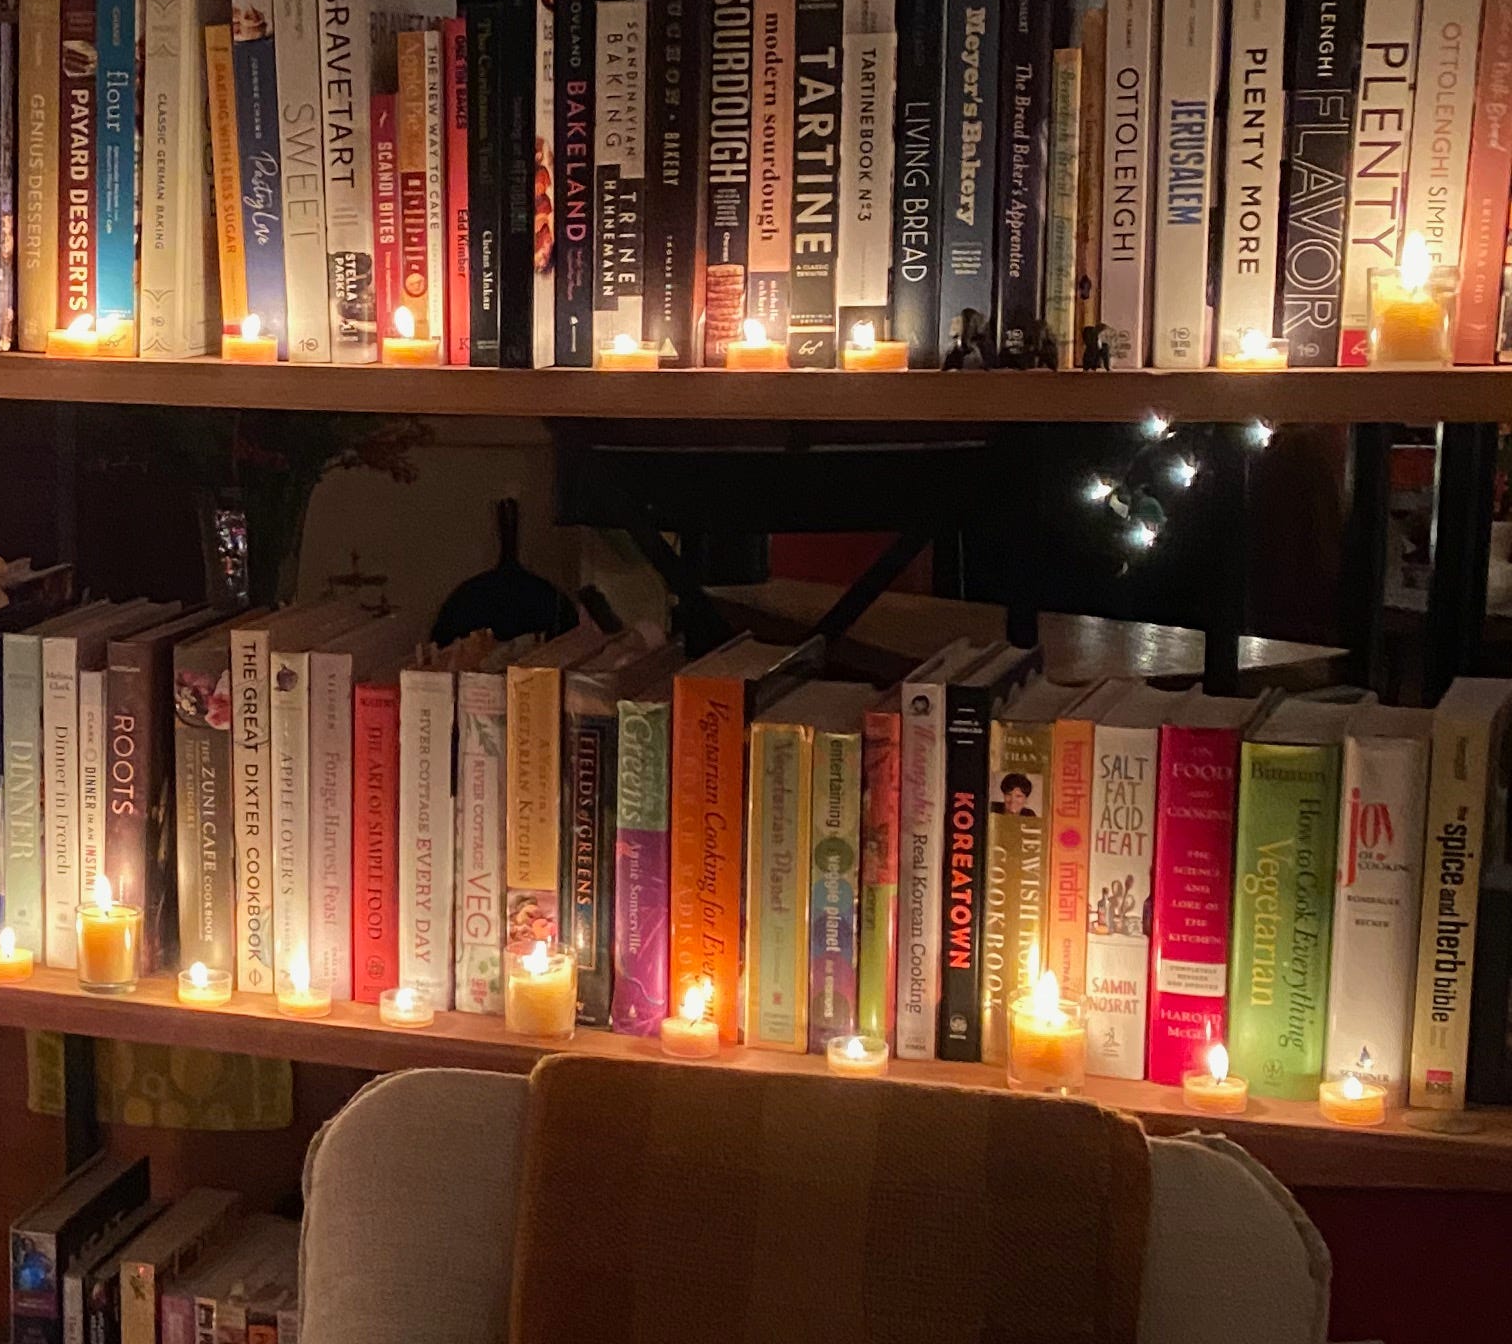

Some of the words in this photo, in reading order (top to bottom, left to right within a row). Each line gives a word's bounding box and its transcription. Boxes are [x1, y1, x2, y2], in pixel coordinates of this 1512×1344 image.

[428, 46, 438, 78] THE
[625, 22, 640, 157] SCANDINAVIAN
[762, 12, 781, 106] modern
[859, 48, 876, 126] TARTINE
[960, 6, 985, 118] Meyer's
[1014, 63, 1032, 90] The
[105, 70, 127, 132] flour
[156, 94, 167, 145] CLASSIC
[215, 63, 229, 120] BAKING
[428, 83, 439, 119] NEW
[456, 89, 467, 129] BAKES
[605, 34, 623, 147] BAKING
[1010, 96, 1031, 139] Bread
[1240, 47, 1268, 172] PLENTY
[1429, 22, 1462, 179] OTTOLENGHI
[28, 94, 46, 170] GENIUS
[69, 89, 90, 181] PAYARD
[217, 126, 232, 163] WITH
[428, 124, 439, 161] WAY
[566, 80, 588, 242] BAKELAND
[662, 132, 679, 186] BAKERY
[796, 47, 836, 255] TARTINE
[858, 130, 874, 181] BOOK
[904, 102, 930, 187] LIVING
[1166, 98, 1208, 226] JERUSALEM
[1351, 41, 1410, 258] PLENTY
[155, 150, 166, 200] GERMAN
[219, 167, 234, 200] LESS
[243, 150, 277, 210] Pastry
[282, 103, 320, 245] SWEET
[376, 141, 392, 197] SCANDI
[429, 166, 439, 183] TO
[757, 113, 779, 242] sourdough
[956, 121, 982, 226] Bakery
[1011, 143, 1029, 197] Baker's
[1110, 67, 1141, 263] OTTOLENGHI
[26, 175, 44, 269] DESSERTS
[154, 205, 165, 249] BAKING
[221, 205, 237, 254] SUGAR
[252, 213, 277, 245] Love
[378, 202, 395, 244] BITES
[430, 191, 441, 230] CAKE
[456, 209, 469, 231] Edd
[602, 180, 616, 296] HAHNEMANN
[618, 191, 637, 284] TRINE
[901, 198, 929, 282] BREAD
[1005, 198, 1027, 279] Apprentice
[1238, 185, 1265, 275] MORE
[1282, 89, 1352, 333] FLAVOR
[68, 188, 89, 311] DESSERTS
[334, 257, 345, 299] PARKS
[344, 253, 356, 301] STELLA
[456, 234, 469, 278] Kimber
[242, 642, 257, 680] THE
[242, 687, 258, 751] GREAT
[417, 708, 432, 755] RIVER
[517, 676, 535, 793] VEGETARIAN
[54, 725, 70, 788] Dinner
[111, 714, 134, 816] ROOTS
[280, 751, 294, 810] APPLE
[323, 751, 340, 810] Forage,
[367, 760, 383, 792] ART
[473, 759, 485, 801] RIVER
[577, 736, 596, 806] FIELDS
[621, 713, 655, 824] Greens
[700, 698, 730, 804] Vegetarian
[1057, 739, 1084, 819] healthy
[1100, 754, 1148, 779] SALT
[1172, 762, 1232, 780] FOOD
[10, 739, 35, 860] DINNER
[56, 791, 69, 809] in
[84, 766, 97, 809] DINNER
[201, 766, 215, 816] ZUNI
[244, 763, 259, 836] DIXTER
[418, 758, 432, 832] COTTAGE
[768, 742, 793, 845] Vegetarian
[826, 740, 847, 828] entertaining
[1104, 782, 1142, 805] FAT
[55, 814, 70, 875] French
[322, 815, 340, 881] Harvest,
[472, 805, 486, 870] COTTAGE
[517, 799, 534, 882] KITCHEN
[1094, 831, 1148, 856] HEAT
[1100, 806, 1143, 831] ACID
[1299, 798, 1322, 844] How
[1338, 787, 1394, 888] joy
[281, 817, 295, 895] LOVER'S
[367, 821, 383, 883] SIMPLE
[415, 838, 433, 911] EVERY
[576, 829, 594, 905] GREENS
[628, 839, 643, 880] Annie
[698, 812, 726, 894] Cooking
[770, 849, 791, 914] Planet
[824, 855, 842, 903] veggie
[911, 834, 929, 872] Real
[948, 791, 975, 969] KOREATOWN
[1019, 822, 1042, 921] JEWISH
[1296, 849, 1314, 869] to
[1435, 823, 1474, 885] spice
[203, 875, 214, 942] COOKBOOK
[245, 847, 262, 961] COOKBOOK
[323, 886, 339, 925] Feast
[367, 888, 383, 940] FOOD
[465, 872, 491, 938] VEG
[627, 883, 643, 956] Somerville
[698, 898, 726, 927] for
[911, 875, 928, 938] Korean
[1059, 860, 1083, 922] indian
[1293, 872, 1315, 922] Cook
[1439, 889, 1458, 917] and
[414, 919, 432, 964] DAY
[824, 906, 842, 952] planet
[1242, 839, 1295, 1007] Vegetarian
[1434, 921, 1468, 973] herb
[908, 942, 928, 1014] Cooking
[1086, 997, 1139, 1016] NOSRAT
[1091, 975, 1138, 996] SAMIN
[1278, 926, 1316, 1053] Everything
[1431, 977, 1457, 1023] bible
